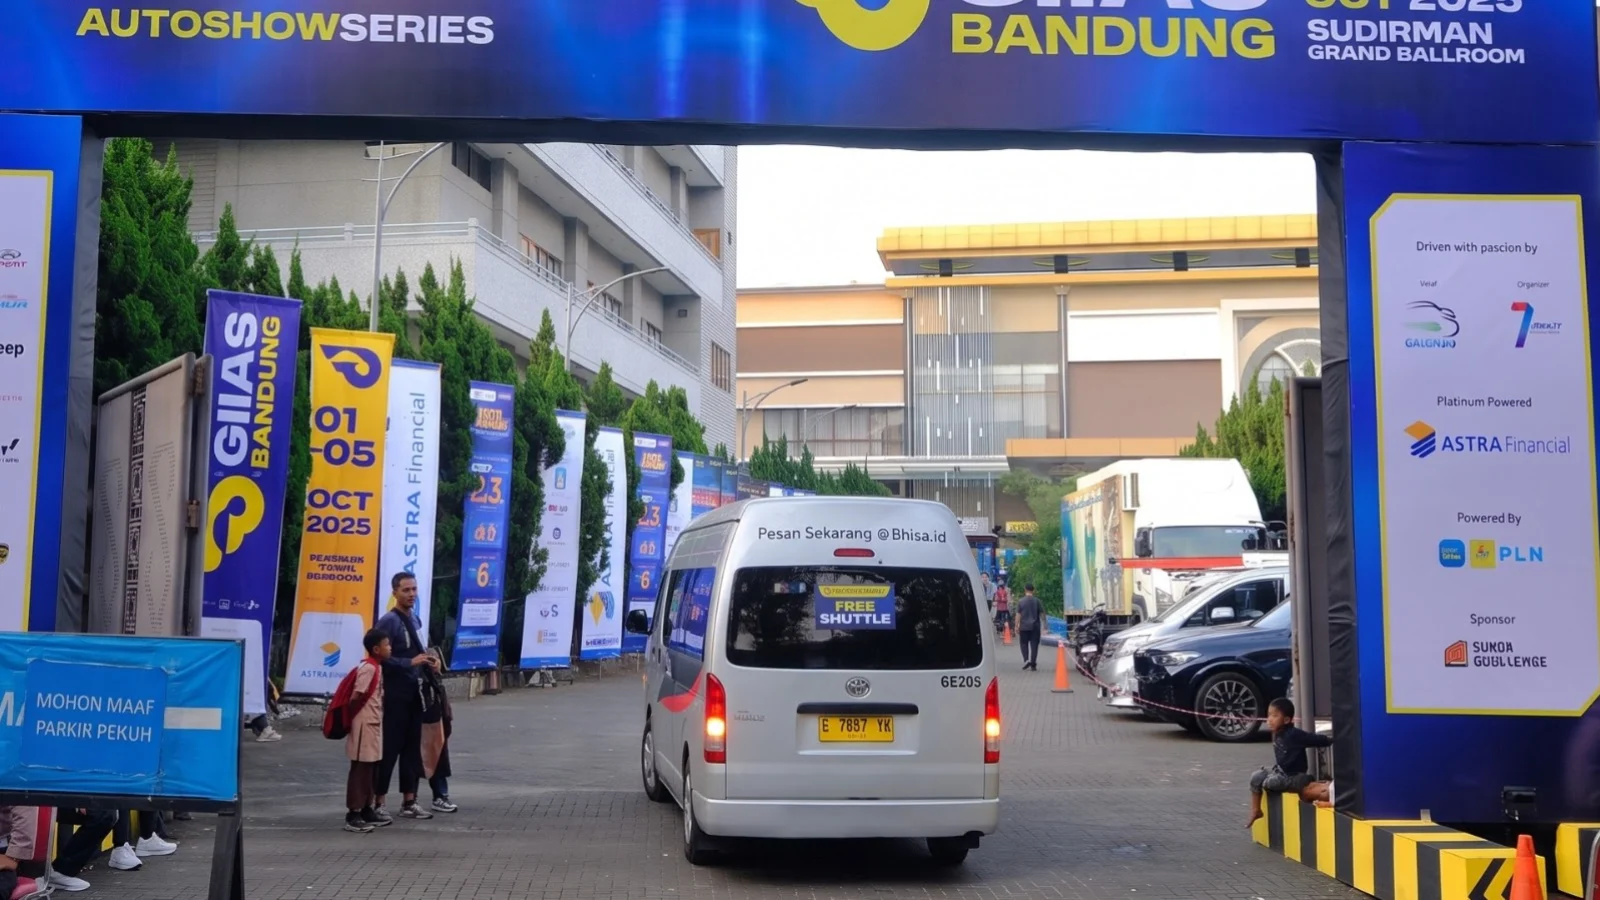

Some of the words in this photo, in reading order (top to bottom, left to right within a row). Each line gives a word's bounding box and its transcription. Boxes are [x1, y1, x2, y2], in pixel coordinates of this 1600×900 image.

[951, 13, 1276, 59] BANDUNG
[1307, 19, 1493, 44] SUDIRMAN
[1307, 45, 1392, 61] GRAND
[1396, 46, 1526, 64] BALLROOM
[1416, 241, 1452, 252] Driven
[1454, 241, 1478, 252] with
[1524, 242, 1538, 255] by
[1517, 281, 1550, 290] Organizer
[213, 312, 258, 467] GIIAS
[251, 315, 281, 469] BANDUNG
[1437, 396, 1485, 407] Platinum
[1487, 396, 1532, 408] Powered
[314, 405, 357, 433] 01
[406, 392, 426, 485] Financial
[1441, 436, 1503, 452] ASTRA
[1505, 436, 1571, 453] Financial
[307, 489, 373, 511] OCT
[306, 515, 371, 535] 2025
[1457, 512, 1505, 523] Powered
[1508, 513, 1522, 526] By
[403, 490, 421, 578] ASTRA
[758, 527, 801, 540] Pesan
[805, 527, 872, 542] Sekarang
[1499, 546, 1543, 562] PLN
[835, 601, 876, 612] FREE
[820, 613, 891, 625] SHUTTLE
[1470, 614, 1516, 626] Sponsor
[36, 692, 102, 712] MOHON
[107, 697, 155, 715] MAAF
[36, 720, 92, 738] PARKIR
[97, 724, 152, 742] PEKUH
[822, 718, 829, 732] E
[877, 718, 891, 732] YK
